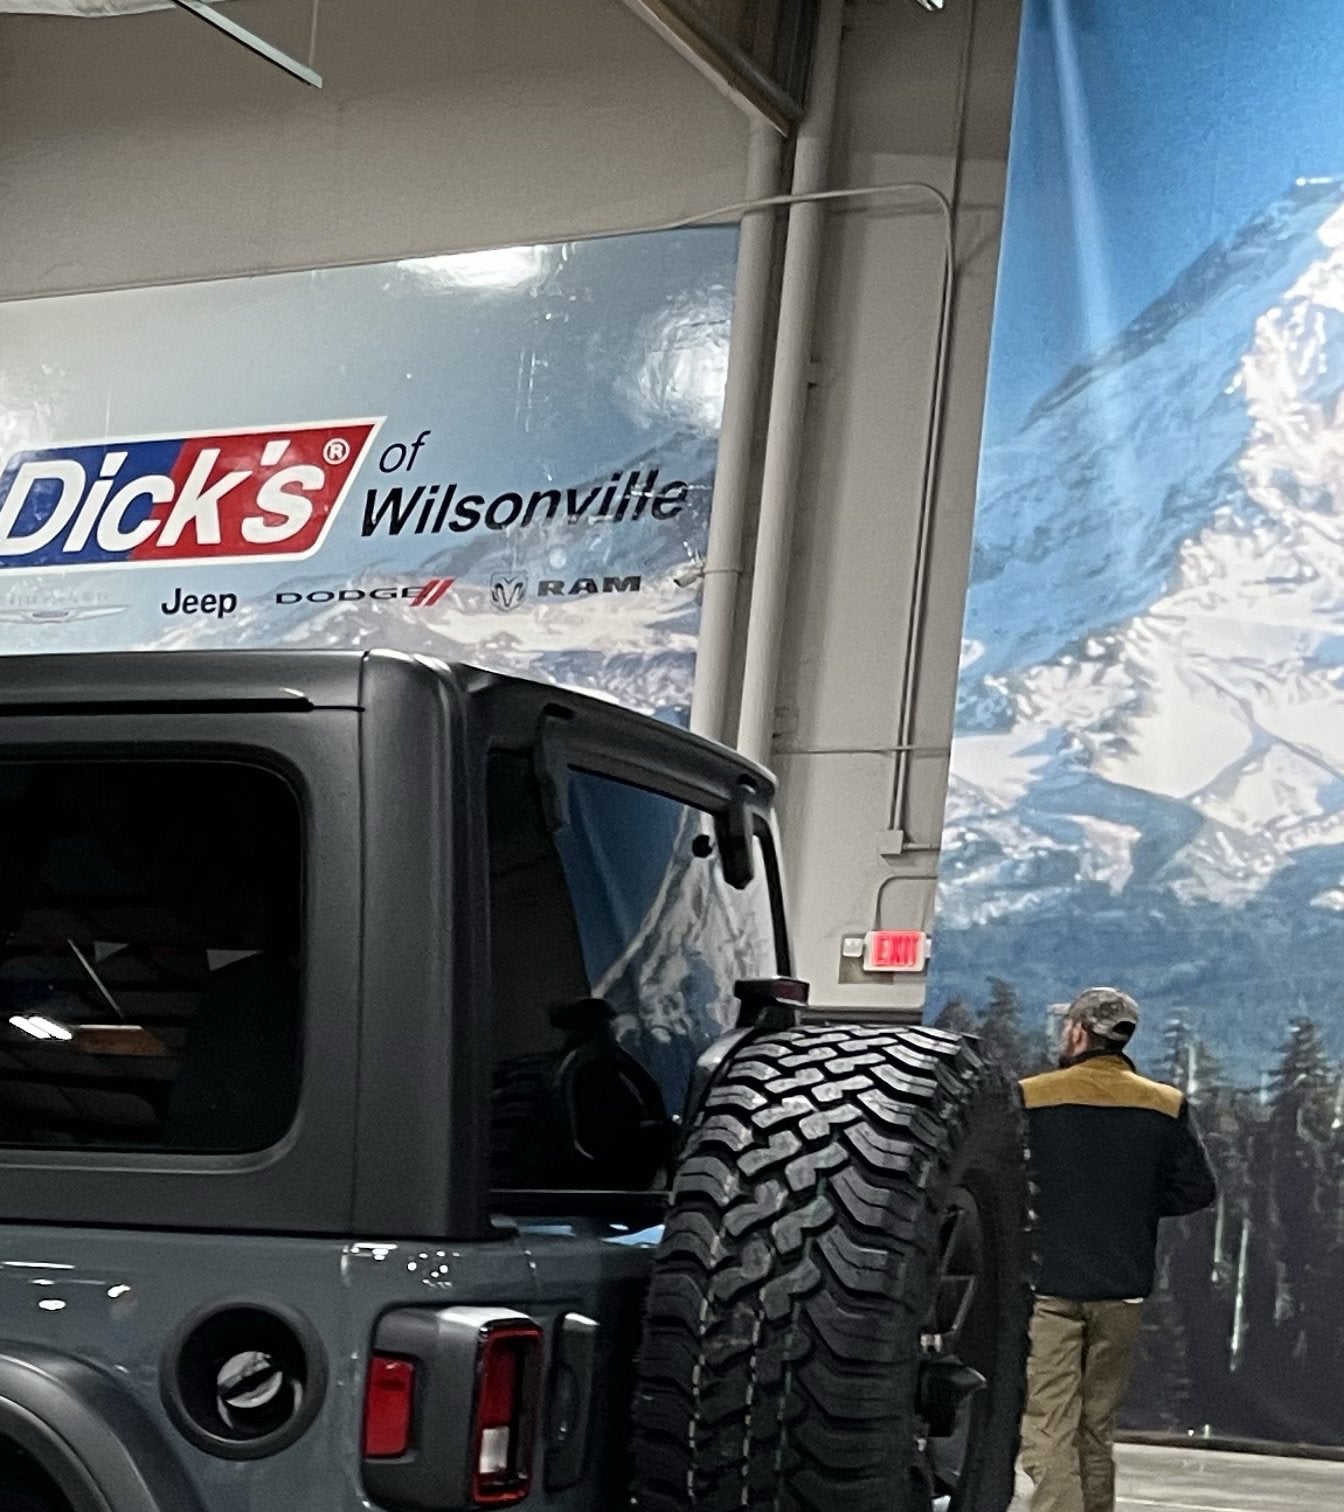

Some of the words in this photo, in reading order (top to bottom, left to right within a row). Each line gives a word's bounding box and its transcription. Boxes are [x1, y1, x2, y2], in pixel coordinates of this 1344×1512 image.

[379, 430, 430, 473] of
[361, 468, 689, 537] Wilsonville
[275, 586, 425, 605] DODGE
[537, 574, 642, 597] RAM
[161, 587, 237, 618] Jeep
[879, 936, 920, 966] EXIT
